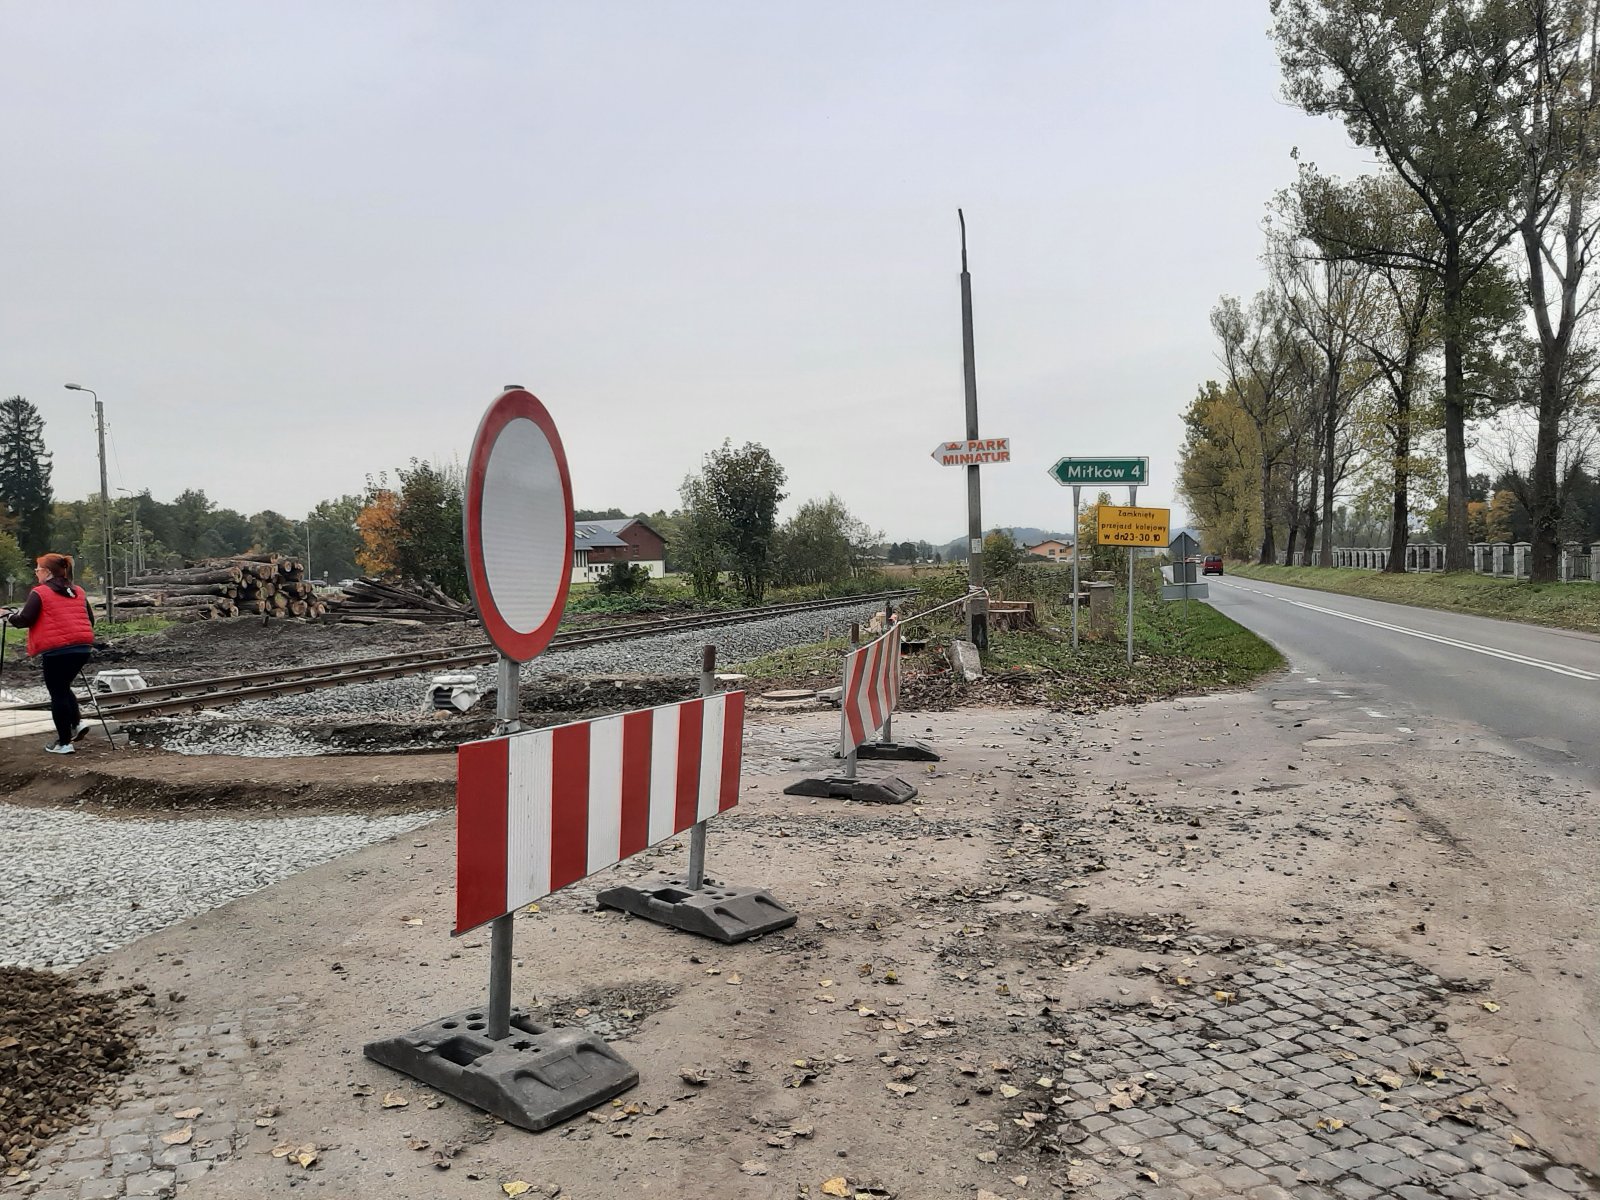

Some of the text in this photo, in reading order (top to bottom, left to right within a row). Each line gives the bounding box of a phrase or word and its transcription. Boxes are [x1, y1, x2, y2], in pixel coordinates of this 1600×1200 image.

[968, 440, 1007, 452] PARK
[942, 452, 1010, 465] MINIATUR
[1067, 464, 1141, 478] Miłków 4
[1118, 509, 1155, 520] Zamknięty
[1101, 523, 1167, 533] przejazd kolejowy
